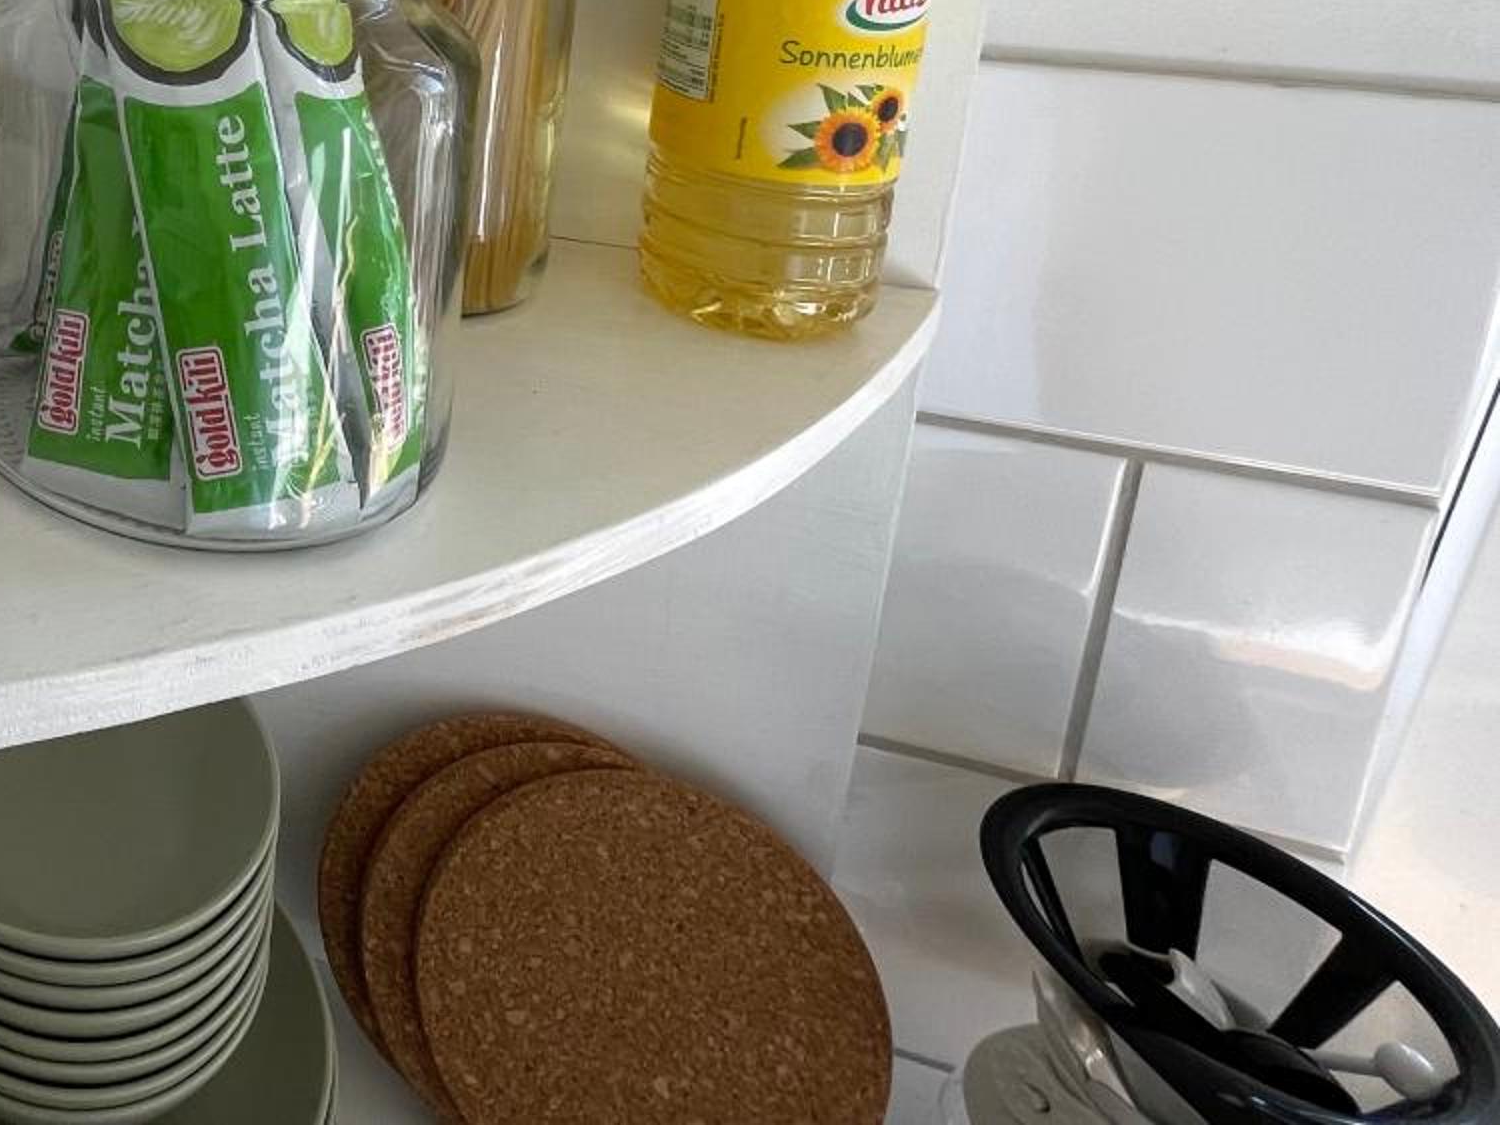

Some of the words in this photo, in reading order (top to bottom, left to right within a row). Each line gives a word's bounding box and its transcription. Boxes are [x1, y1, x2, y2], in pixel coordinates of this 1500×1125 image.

[216, 115, 267, 252] Latte
[41, 366, 75, 424] gold
[184, 356, 226, 405] kili
[196, 409, 238, 467] gold
